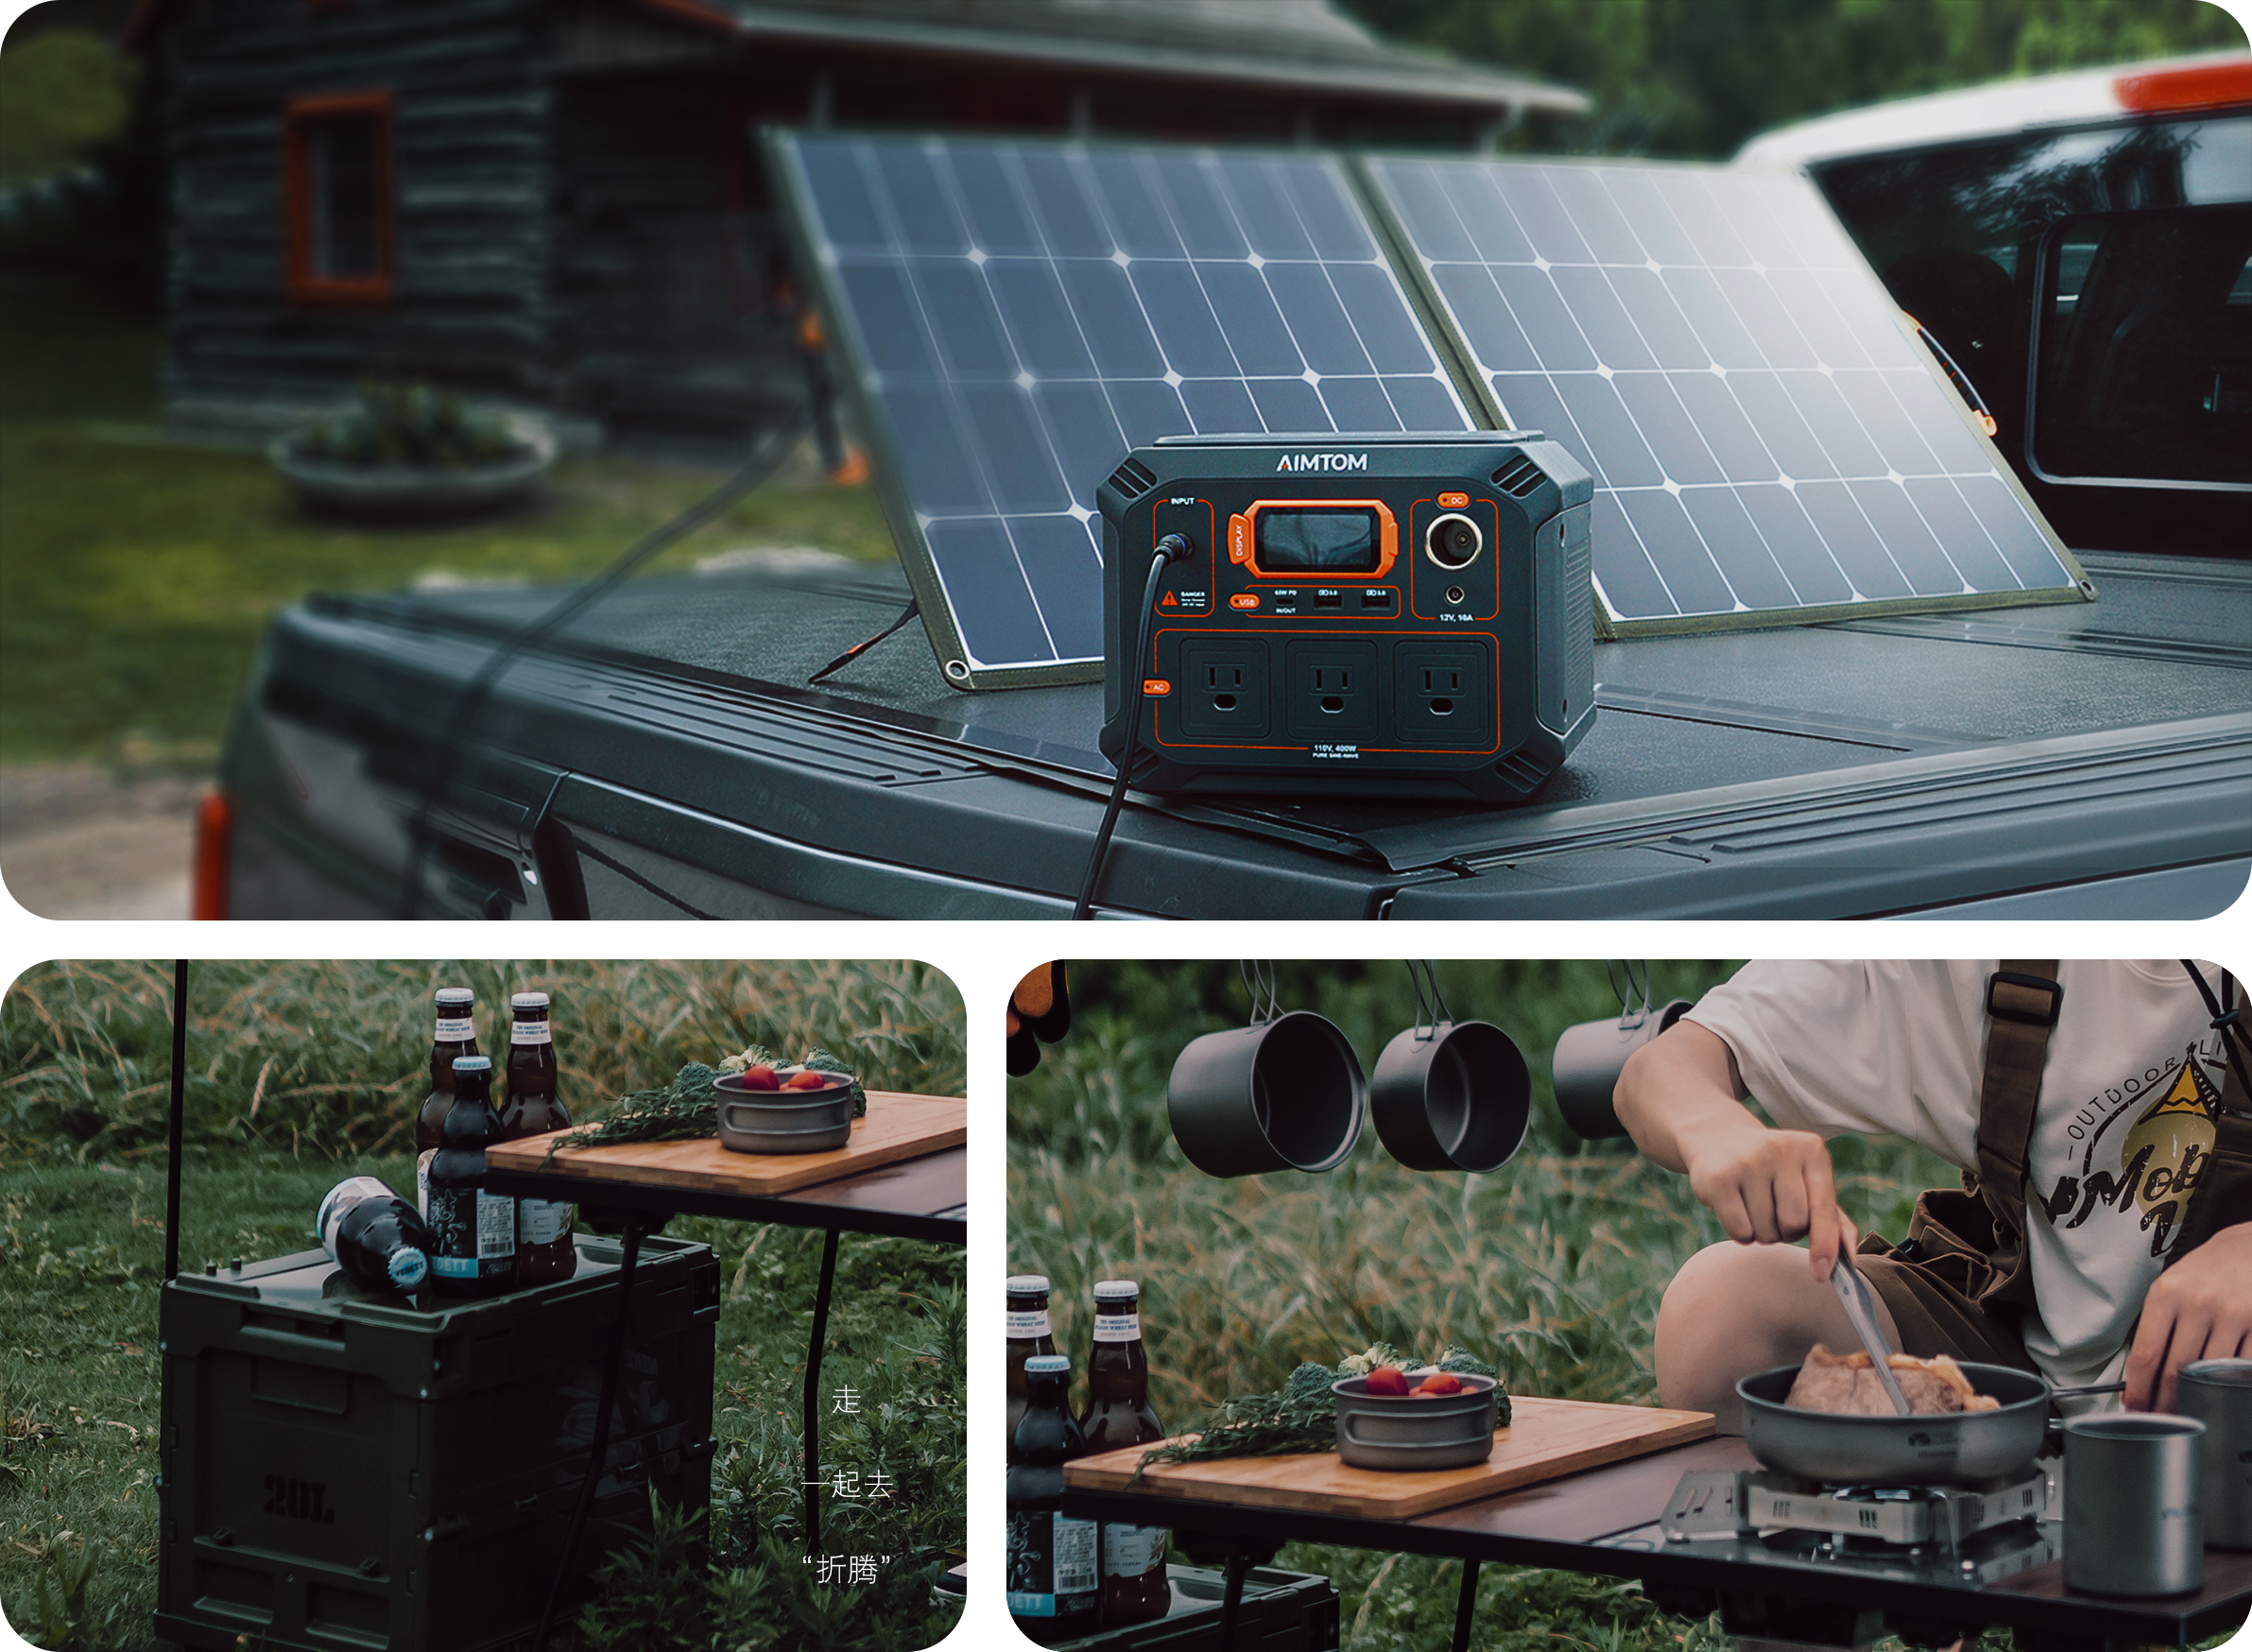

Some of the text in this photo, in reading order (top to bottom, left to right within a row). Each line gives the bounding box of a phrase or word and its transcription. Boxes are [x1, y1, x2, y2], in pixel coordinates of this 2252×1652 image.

[1276, 453, 1368, 472] AIMTOM
[1171, 497, 1195, 506] INPUT
[1451, 496, 1463, 505] DC
[1235, 525, 1244, 557] DISPLAY
[1239, 598, 1254, 607] USB
[1153, 683, 1164, 692] AC
[2067, 1057, 2175, 1141] OUTDOOR
[264, 1473, 335, 1525] 20L
